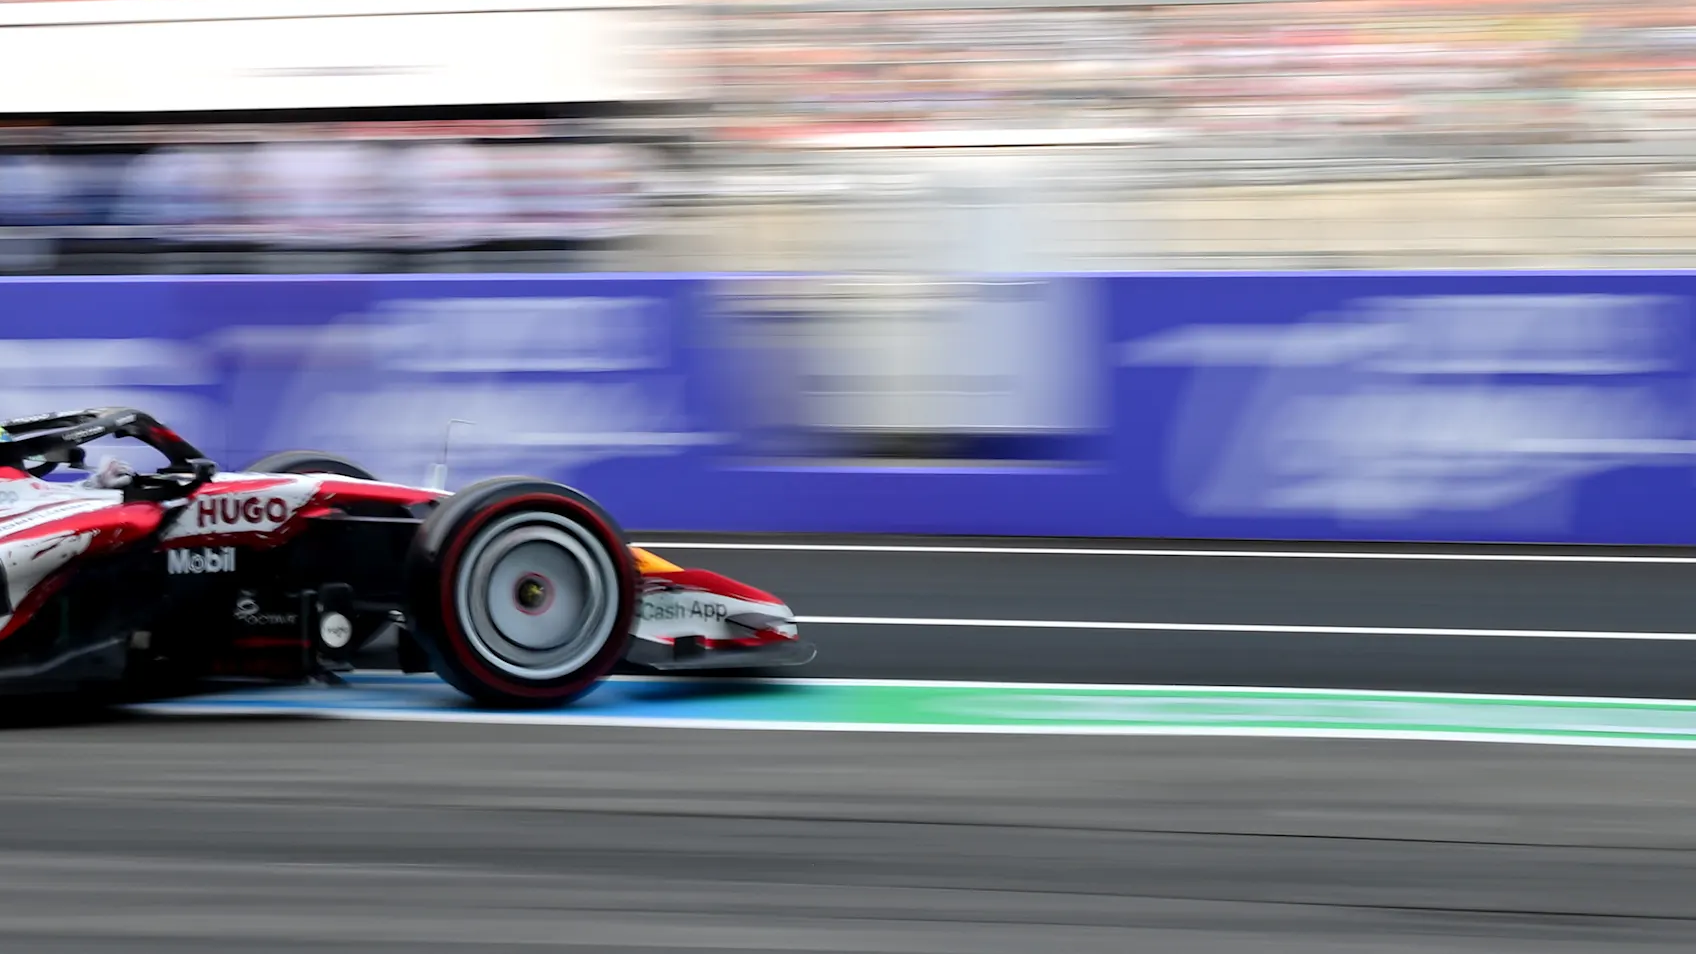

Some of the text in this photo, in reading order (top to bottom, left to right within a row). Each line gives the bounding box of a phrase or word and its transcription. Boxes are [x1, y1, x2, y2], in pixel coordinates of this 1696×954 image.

[197, 497, 288, 528] HUGO
[167, 546, 236, 575] Mobil
[641, 600, 727, 624] Cash App
